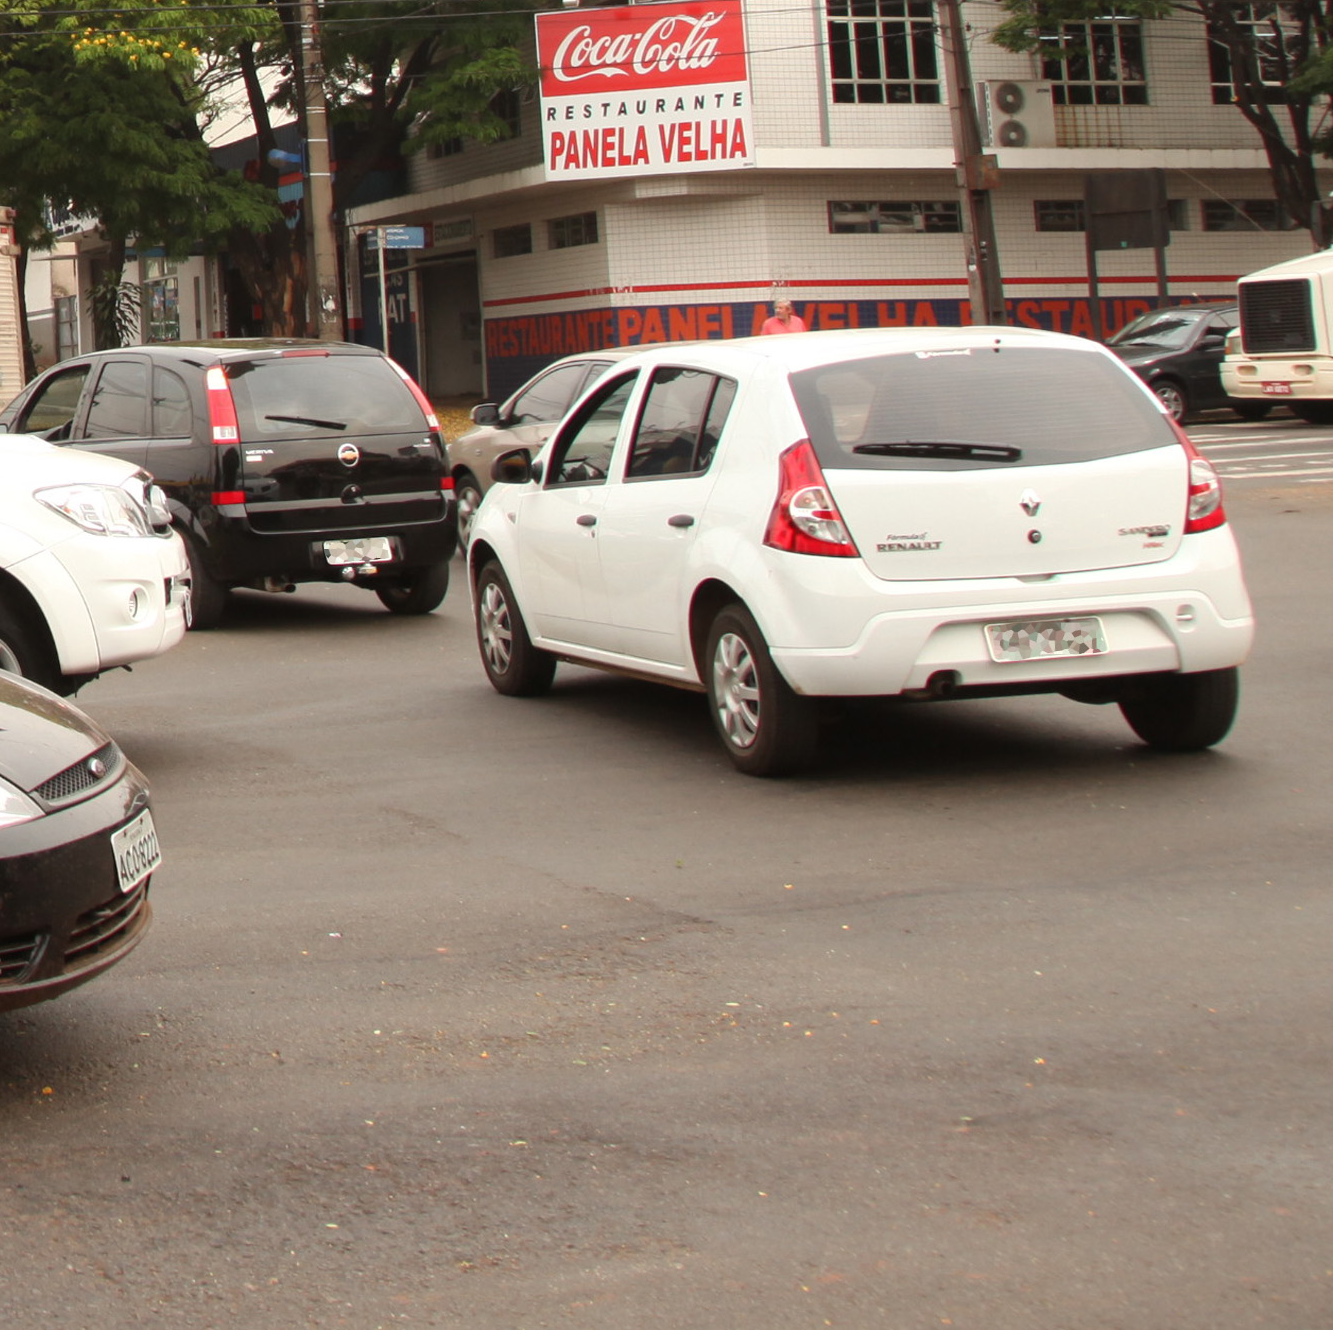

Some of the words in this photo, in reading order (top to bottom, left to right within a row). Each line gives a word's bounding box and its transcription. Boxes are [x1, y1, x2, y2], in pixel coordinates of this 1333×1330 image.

[552, 10, 726, 82] Coca-Cola
[547, 92, 742, 121] RESTAURANTE
[550, 125, 650, 170] PANELA
[658, 118, 747, 163] VELHA
[486, 310, 615, 359] RESTAURANTE
[876, 541, 943, 552] RENAULT
[1118, 524, 1172, 536] SANDERO
